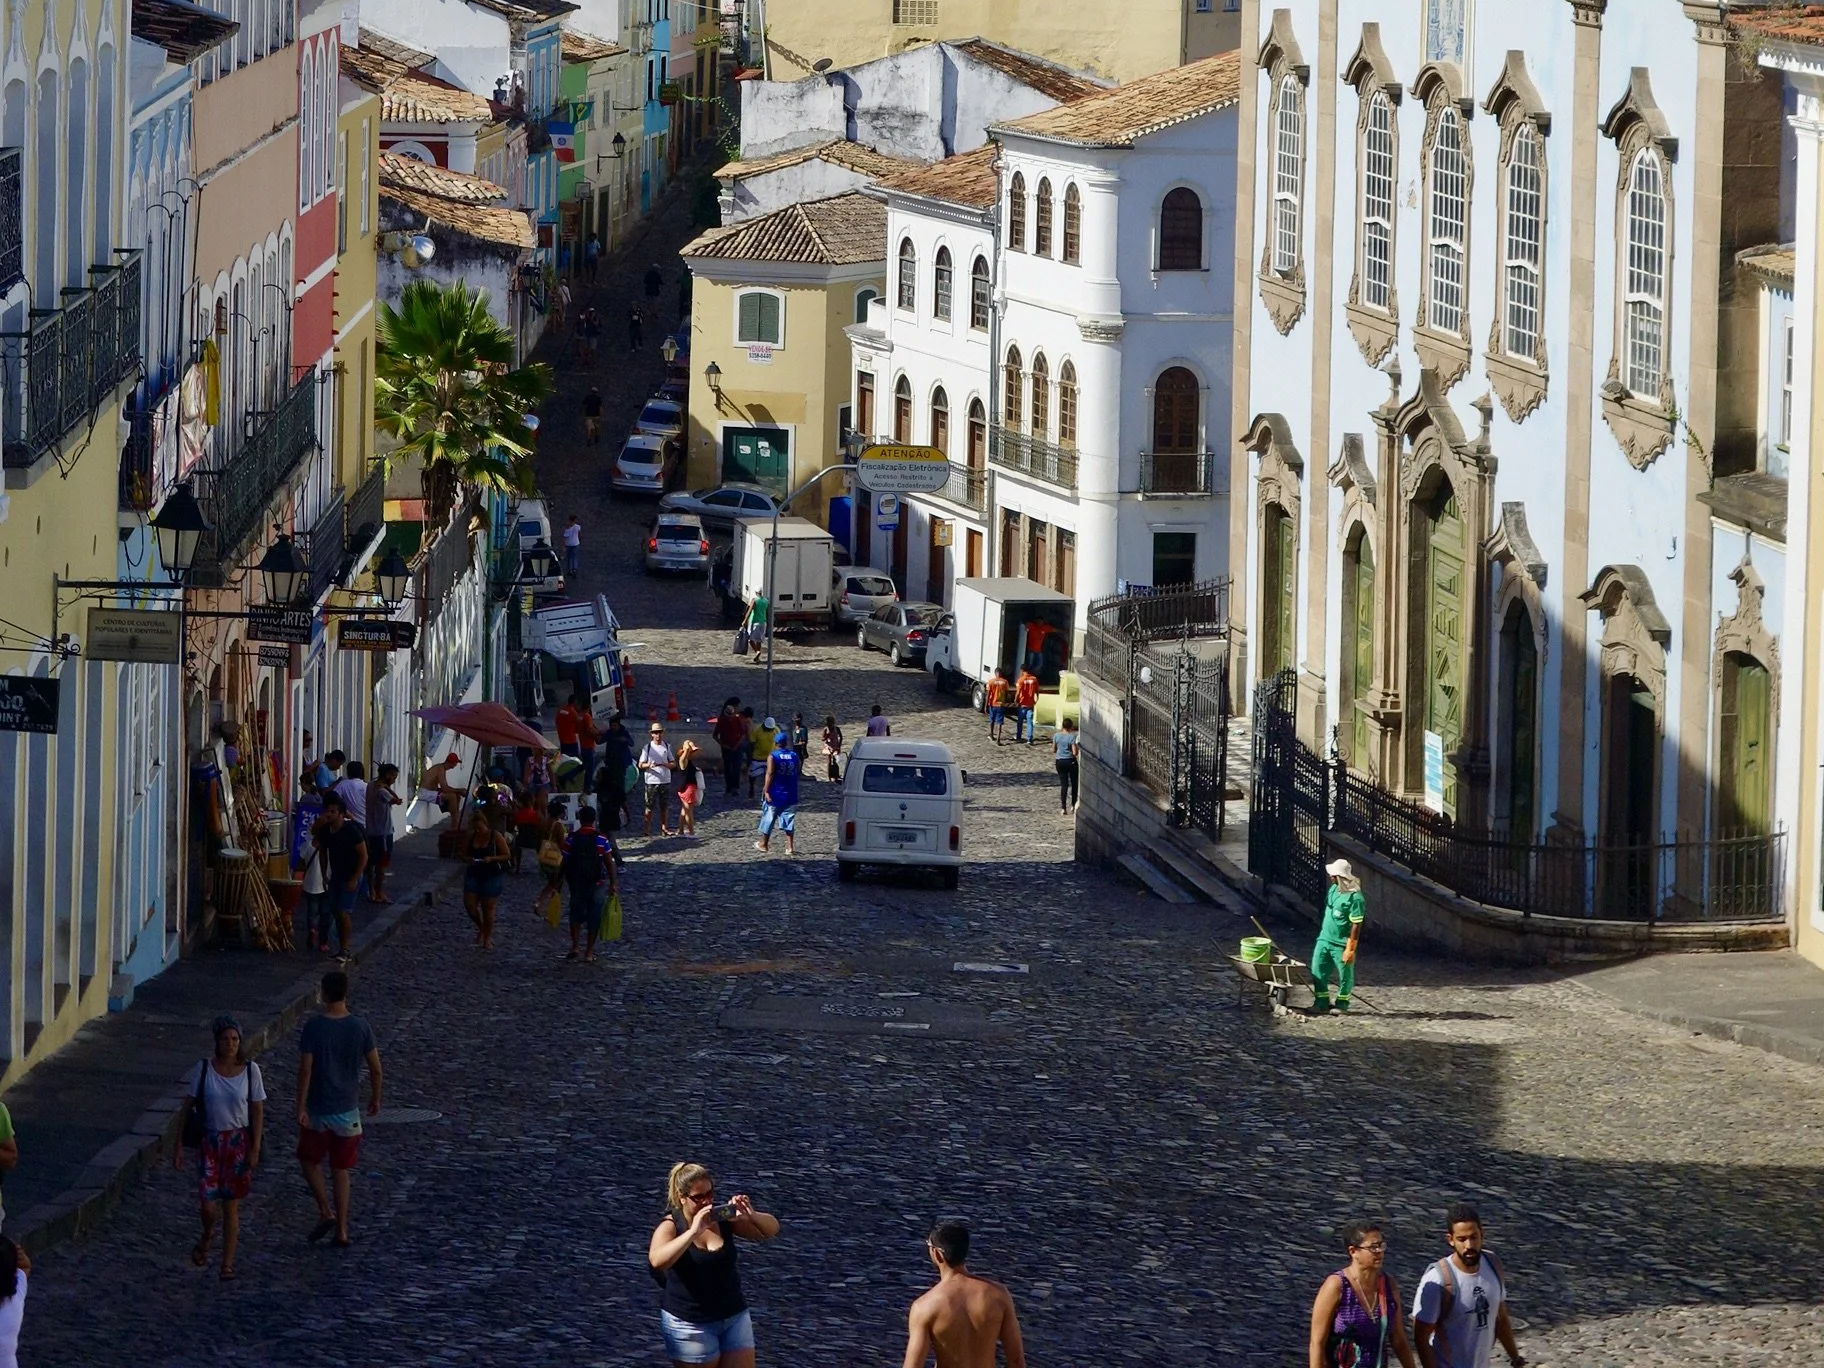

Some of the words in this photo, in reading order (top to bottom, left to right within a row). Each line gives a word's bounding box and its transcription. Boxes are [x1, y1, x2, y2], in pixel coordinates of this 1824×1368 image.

[880, 448, 931, 459] ATENÇÃO
[861, 463, 907, 472] Fiscalização
[908, 464, 947, 473] Eletrônica
[103, 618, 126, 626] CENTRO
[136, 619, 166, 627] CULTURAS
[280, 611, 312, 627] ARTES
[95, 626, 129, 634] POPULARES
